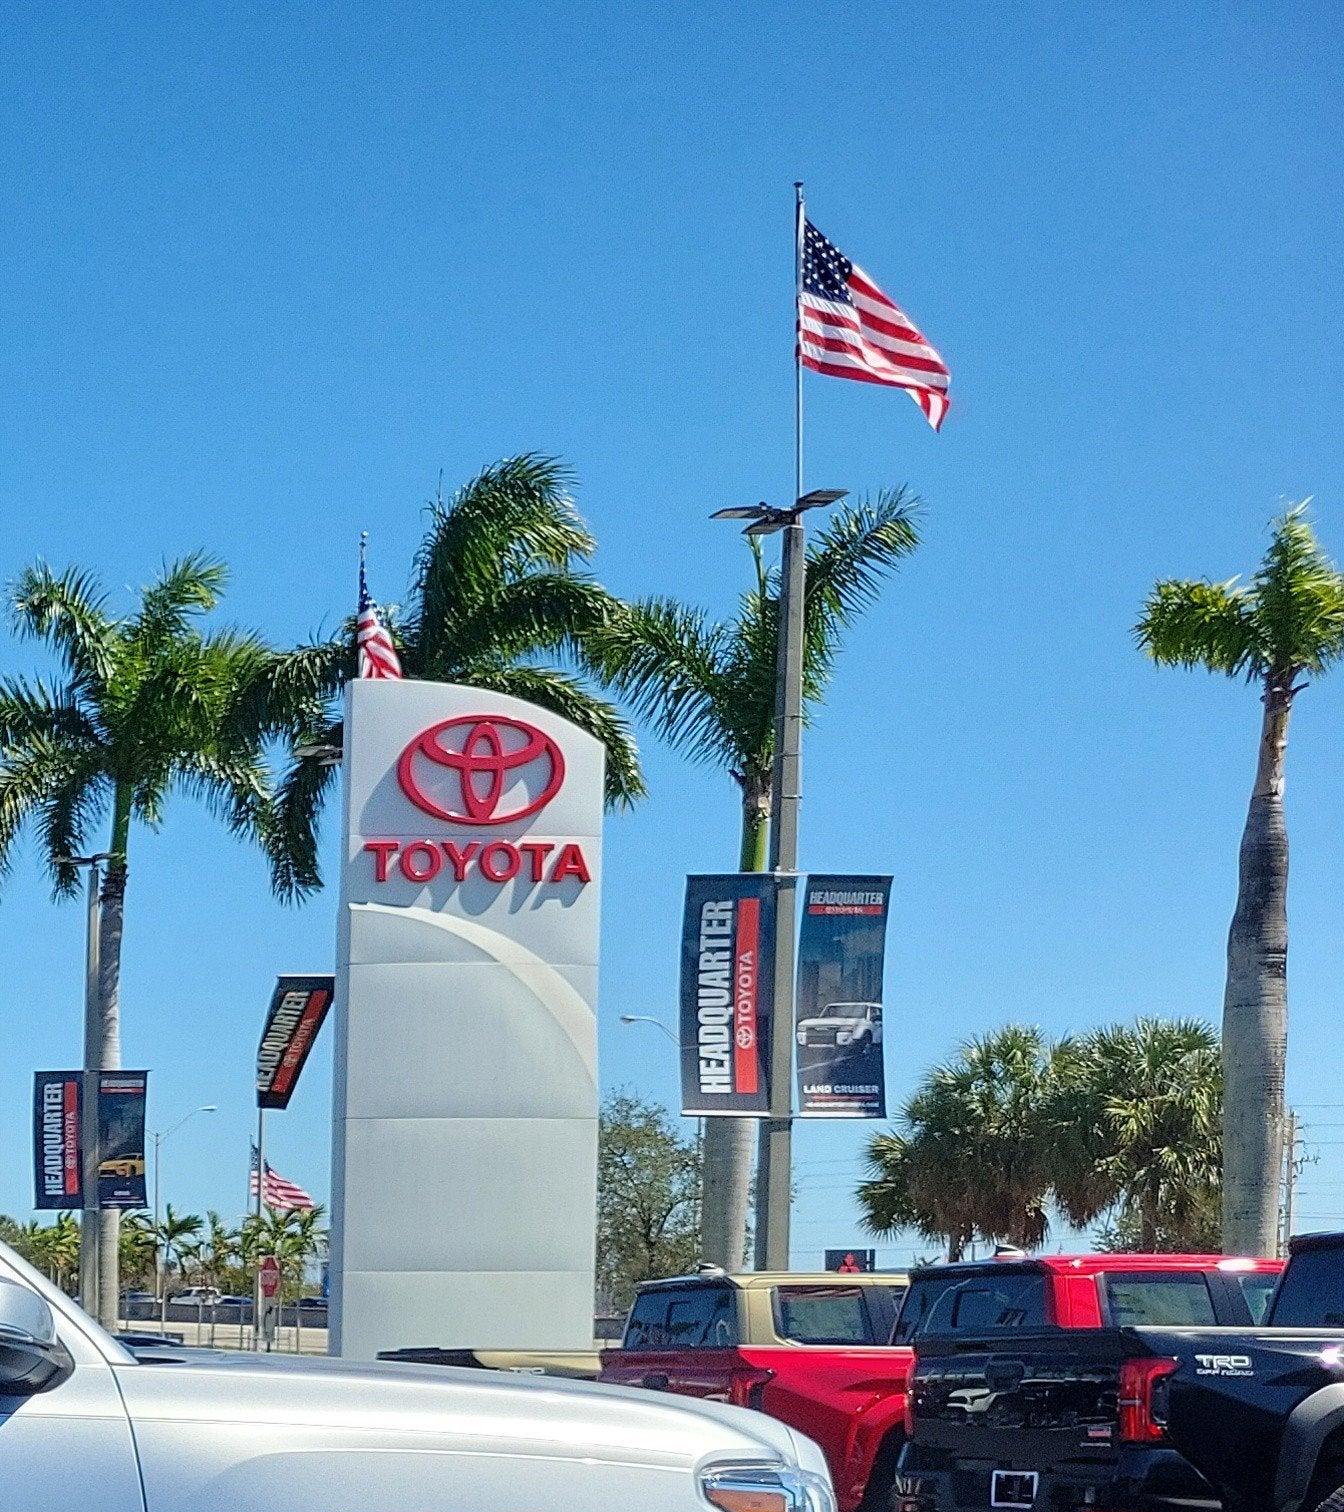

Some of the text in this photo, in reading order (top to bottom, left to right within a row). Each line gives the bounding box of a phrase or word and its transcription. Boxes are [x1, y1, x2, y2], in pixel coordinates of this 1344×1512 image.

[363, 839, 592, 883] TOYOTA
[809, 890, 884, 906] HEADQUARTER
[697, 899, 735, 1095] HEADQUARTER
[738, 950, 753, 1023] TOYOTA
[255, 990, 311, 1092] HEADQUARTER
[803, 1084, 880, 1095] LAND CRUISER
[43, 1082, 65, 1195] HEADQUARTER
[64, 1111, 77, 1155] TOYOTA
[1194, 1354, 1253, 1370] TRD
